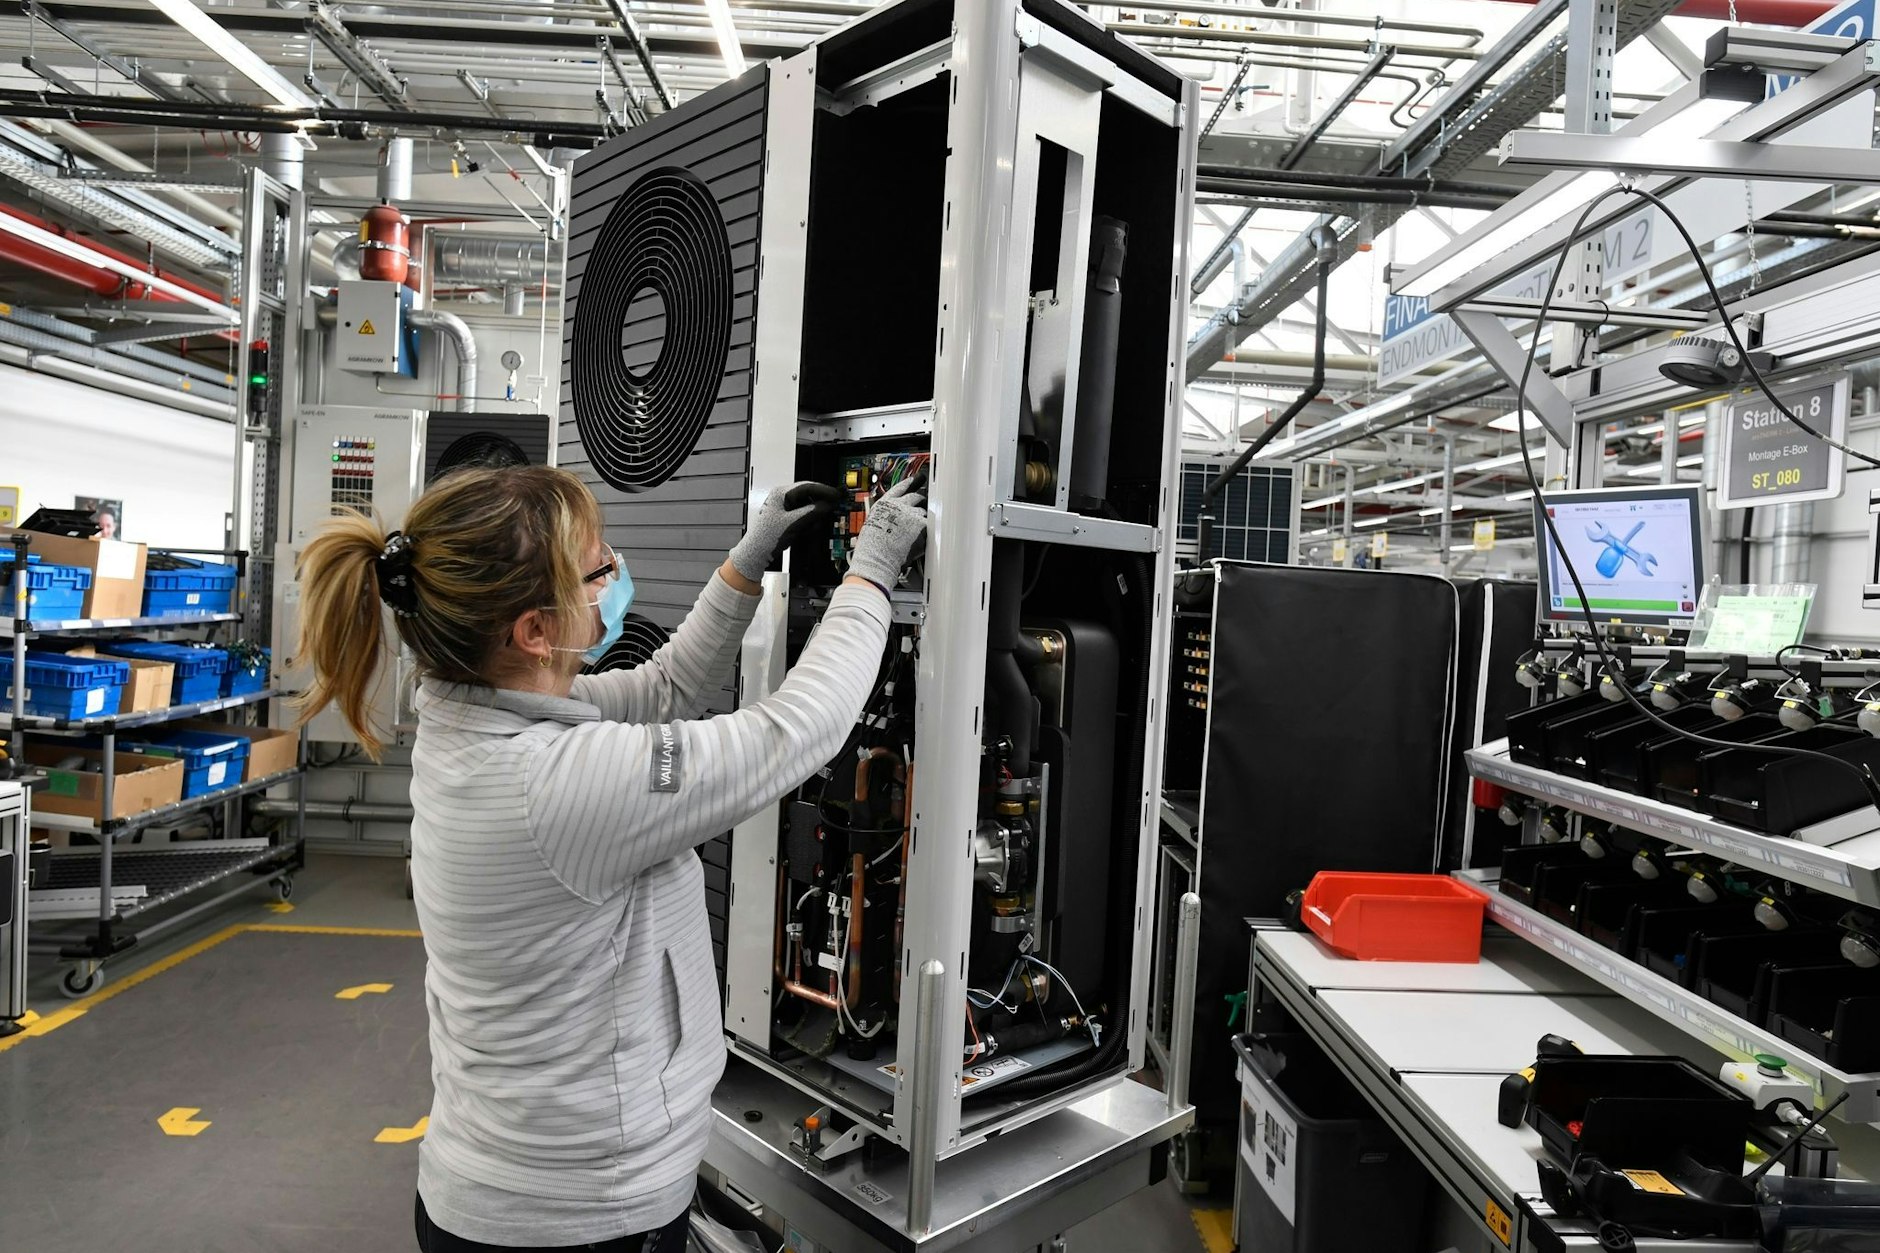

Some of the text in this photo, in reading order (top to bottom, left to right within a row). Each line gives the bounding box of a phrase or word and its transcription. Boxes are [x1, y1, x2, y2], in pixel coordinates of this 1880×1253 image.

[1632, 218, 1650, 260] 2
[1384, 294, 1430, 331] FINA
[1741, 395, 1821, 431] Station 8
[1748, 444, 1808, 463] Montage E-Box
[1751, 468, 1801, 491] ST_080
